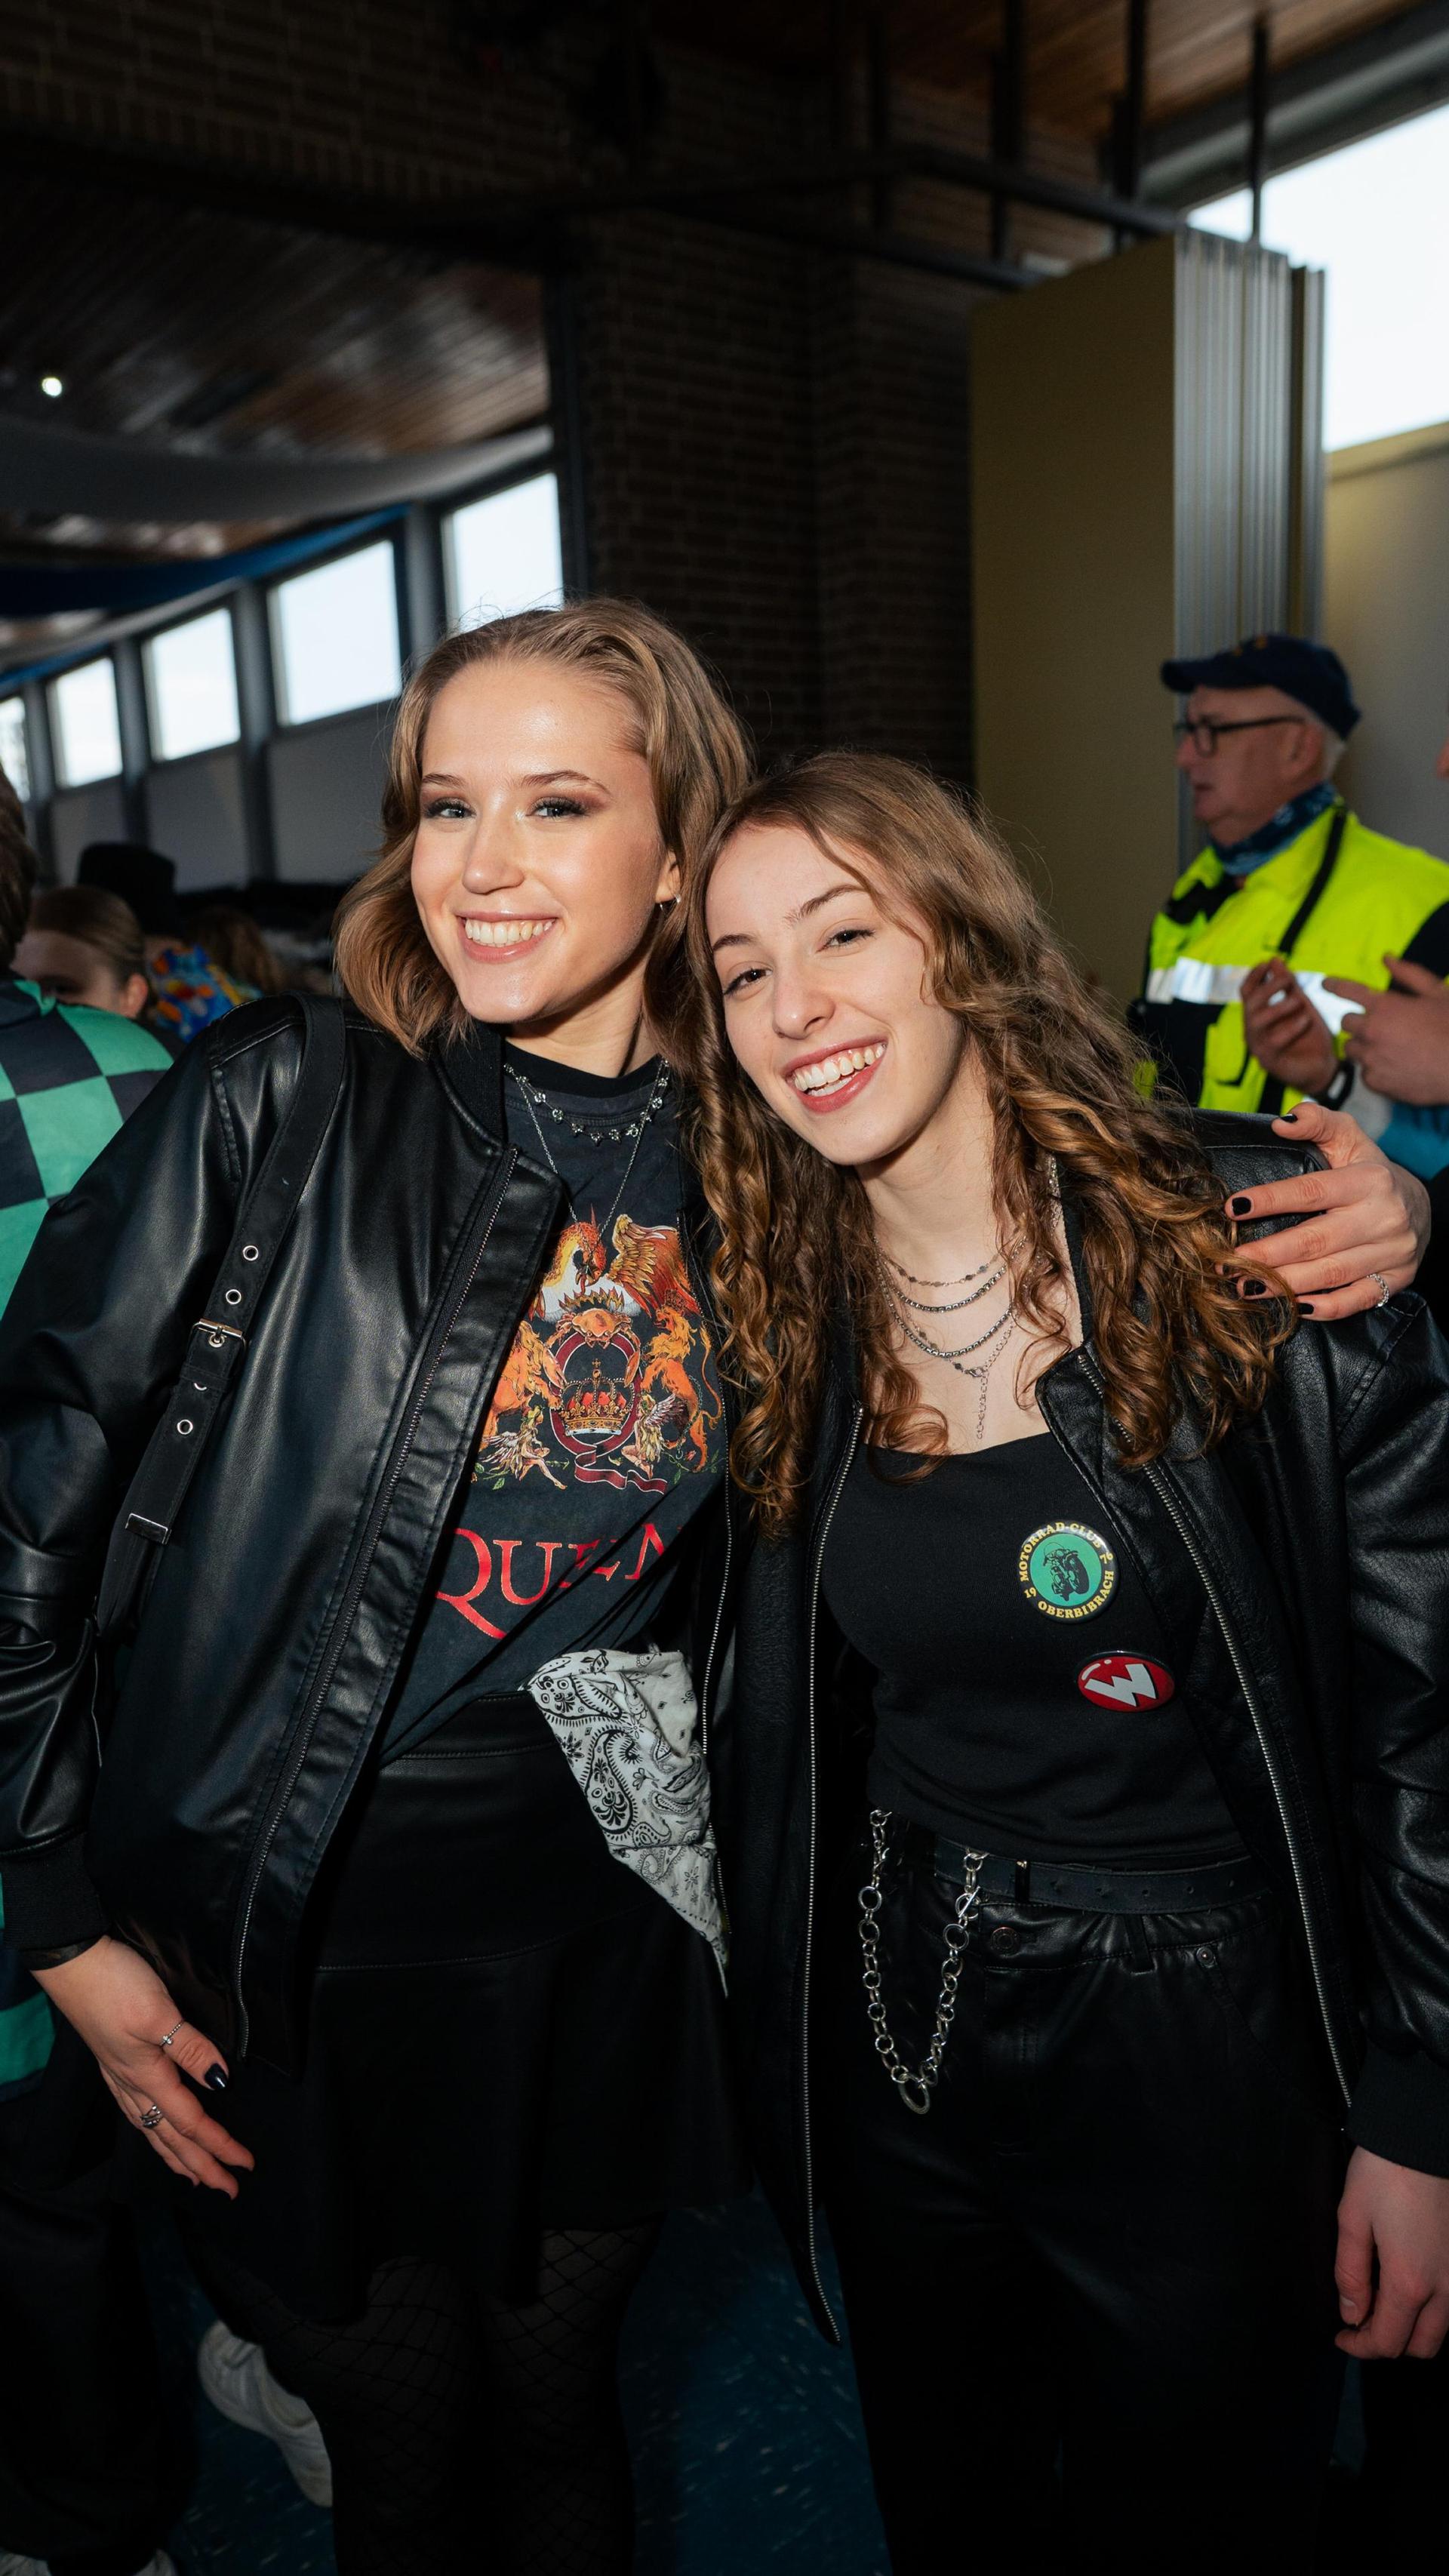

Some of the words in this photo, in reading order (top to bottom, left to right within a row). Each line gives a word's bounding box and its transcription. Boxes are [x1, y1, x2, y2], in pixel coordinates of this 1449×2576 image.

[1019, 1522, 1065, 1582] MOTORRAD
[1069, 1522, 1103, 1549] CLUB
[1024, 1588, 1037, 1599] 19
[1100, 1552, 1113, 1564] 76
[1038, 1570, 1114, 1618] OBERBIBRACH
[1084, 1663, 1156, 1707] W
